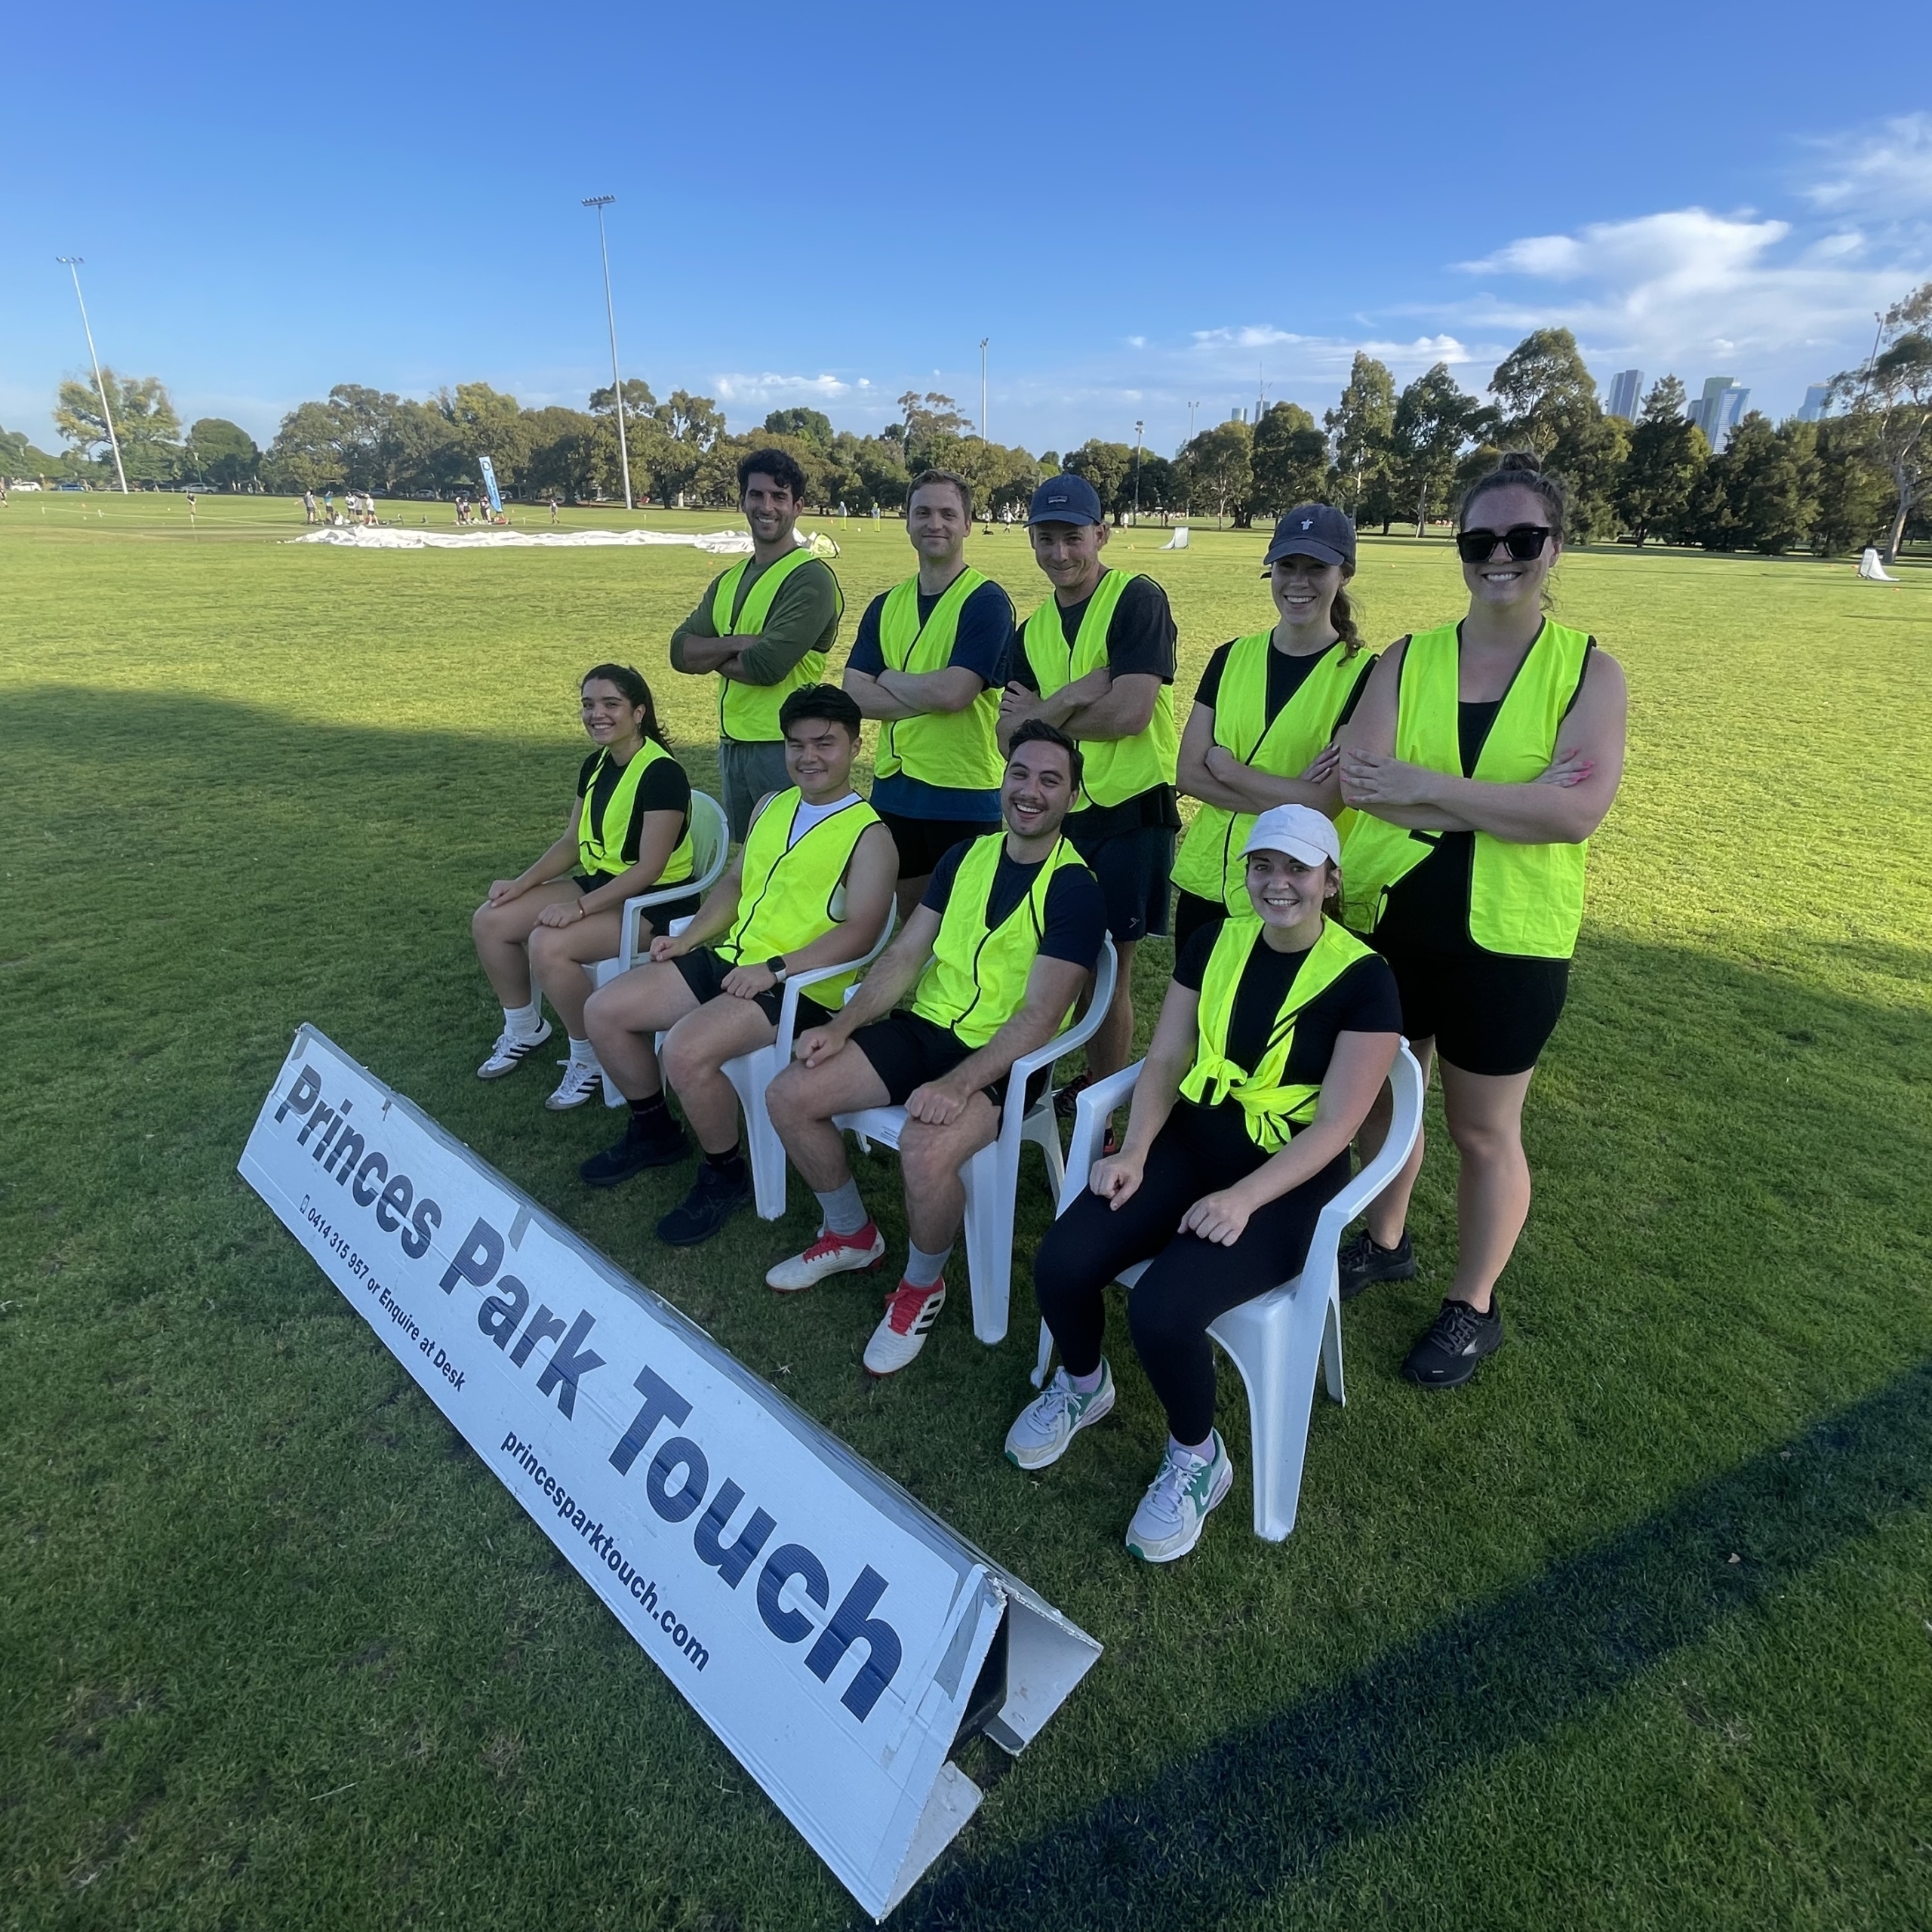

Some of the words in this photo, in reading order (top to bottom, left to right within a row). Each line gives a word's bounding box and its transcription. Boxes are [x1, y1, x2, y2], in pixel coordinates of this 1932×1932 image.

[274, 1064, 441, 1259] Princes
[438, 1217, 607, 1422] Park
[608, 1364, 903, 1723] Touch
[308, 1208, 331, 1238] 0414
[330, 1232, 350, 1259] 315
[348, 1253, 370, 1279] 957
[368, 1278, 380, 1294] or
[378, 1287, 420, 1340] Enquire
[420, 1337, 435, 1358] at
[433, 1349, 466, 1392] Desk
[501, 1432, 710, 1672] princesparktouch.com
